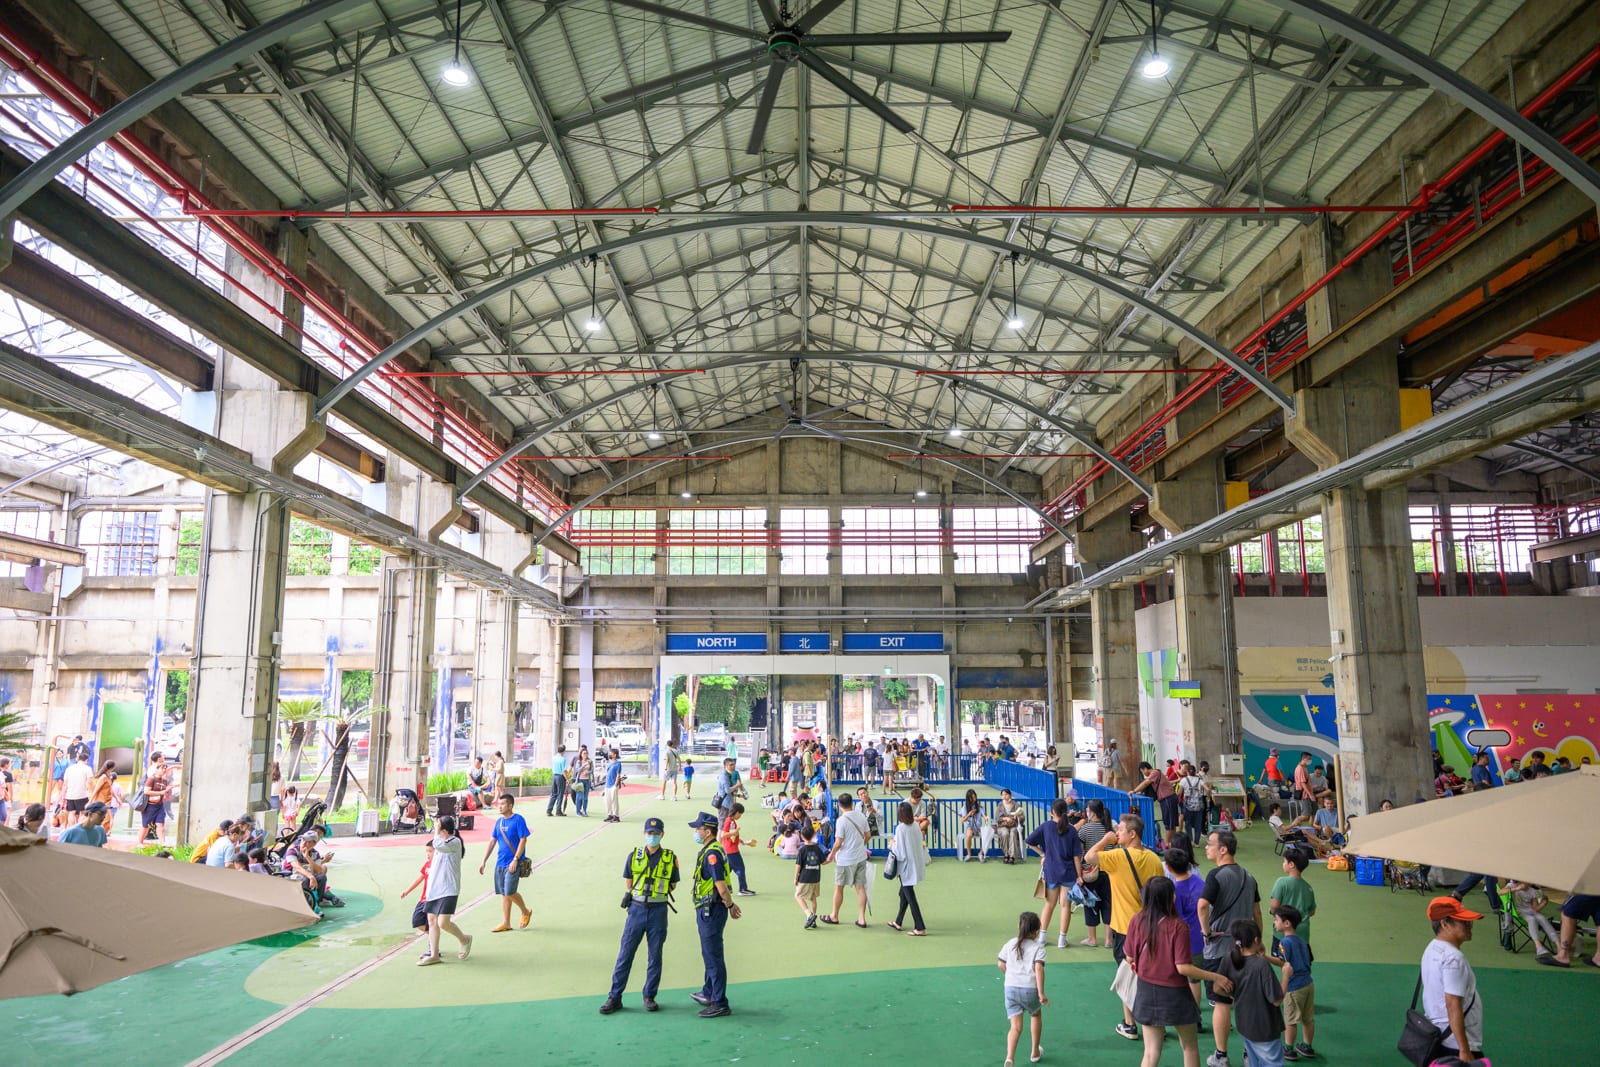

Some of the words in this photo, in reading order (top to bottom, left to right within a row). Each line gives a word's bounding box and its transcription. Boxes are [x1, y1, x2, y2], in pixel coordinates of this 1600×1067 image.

[697, 637, 737, 648] NORTH
[799, 637, 811, 649] 北
[880, 637, 905, 648] EXIT
